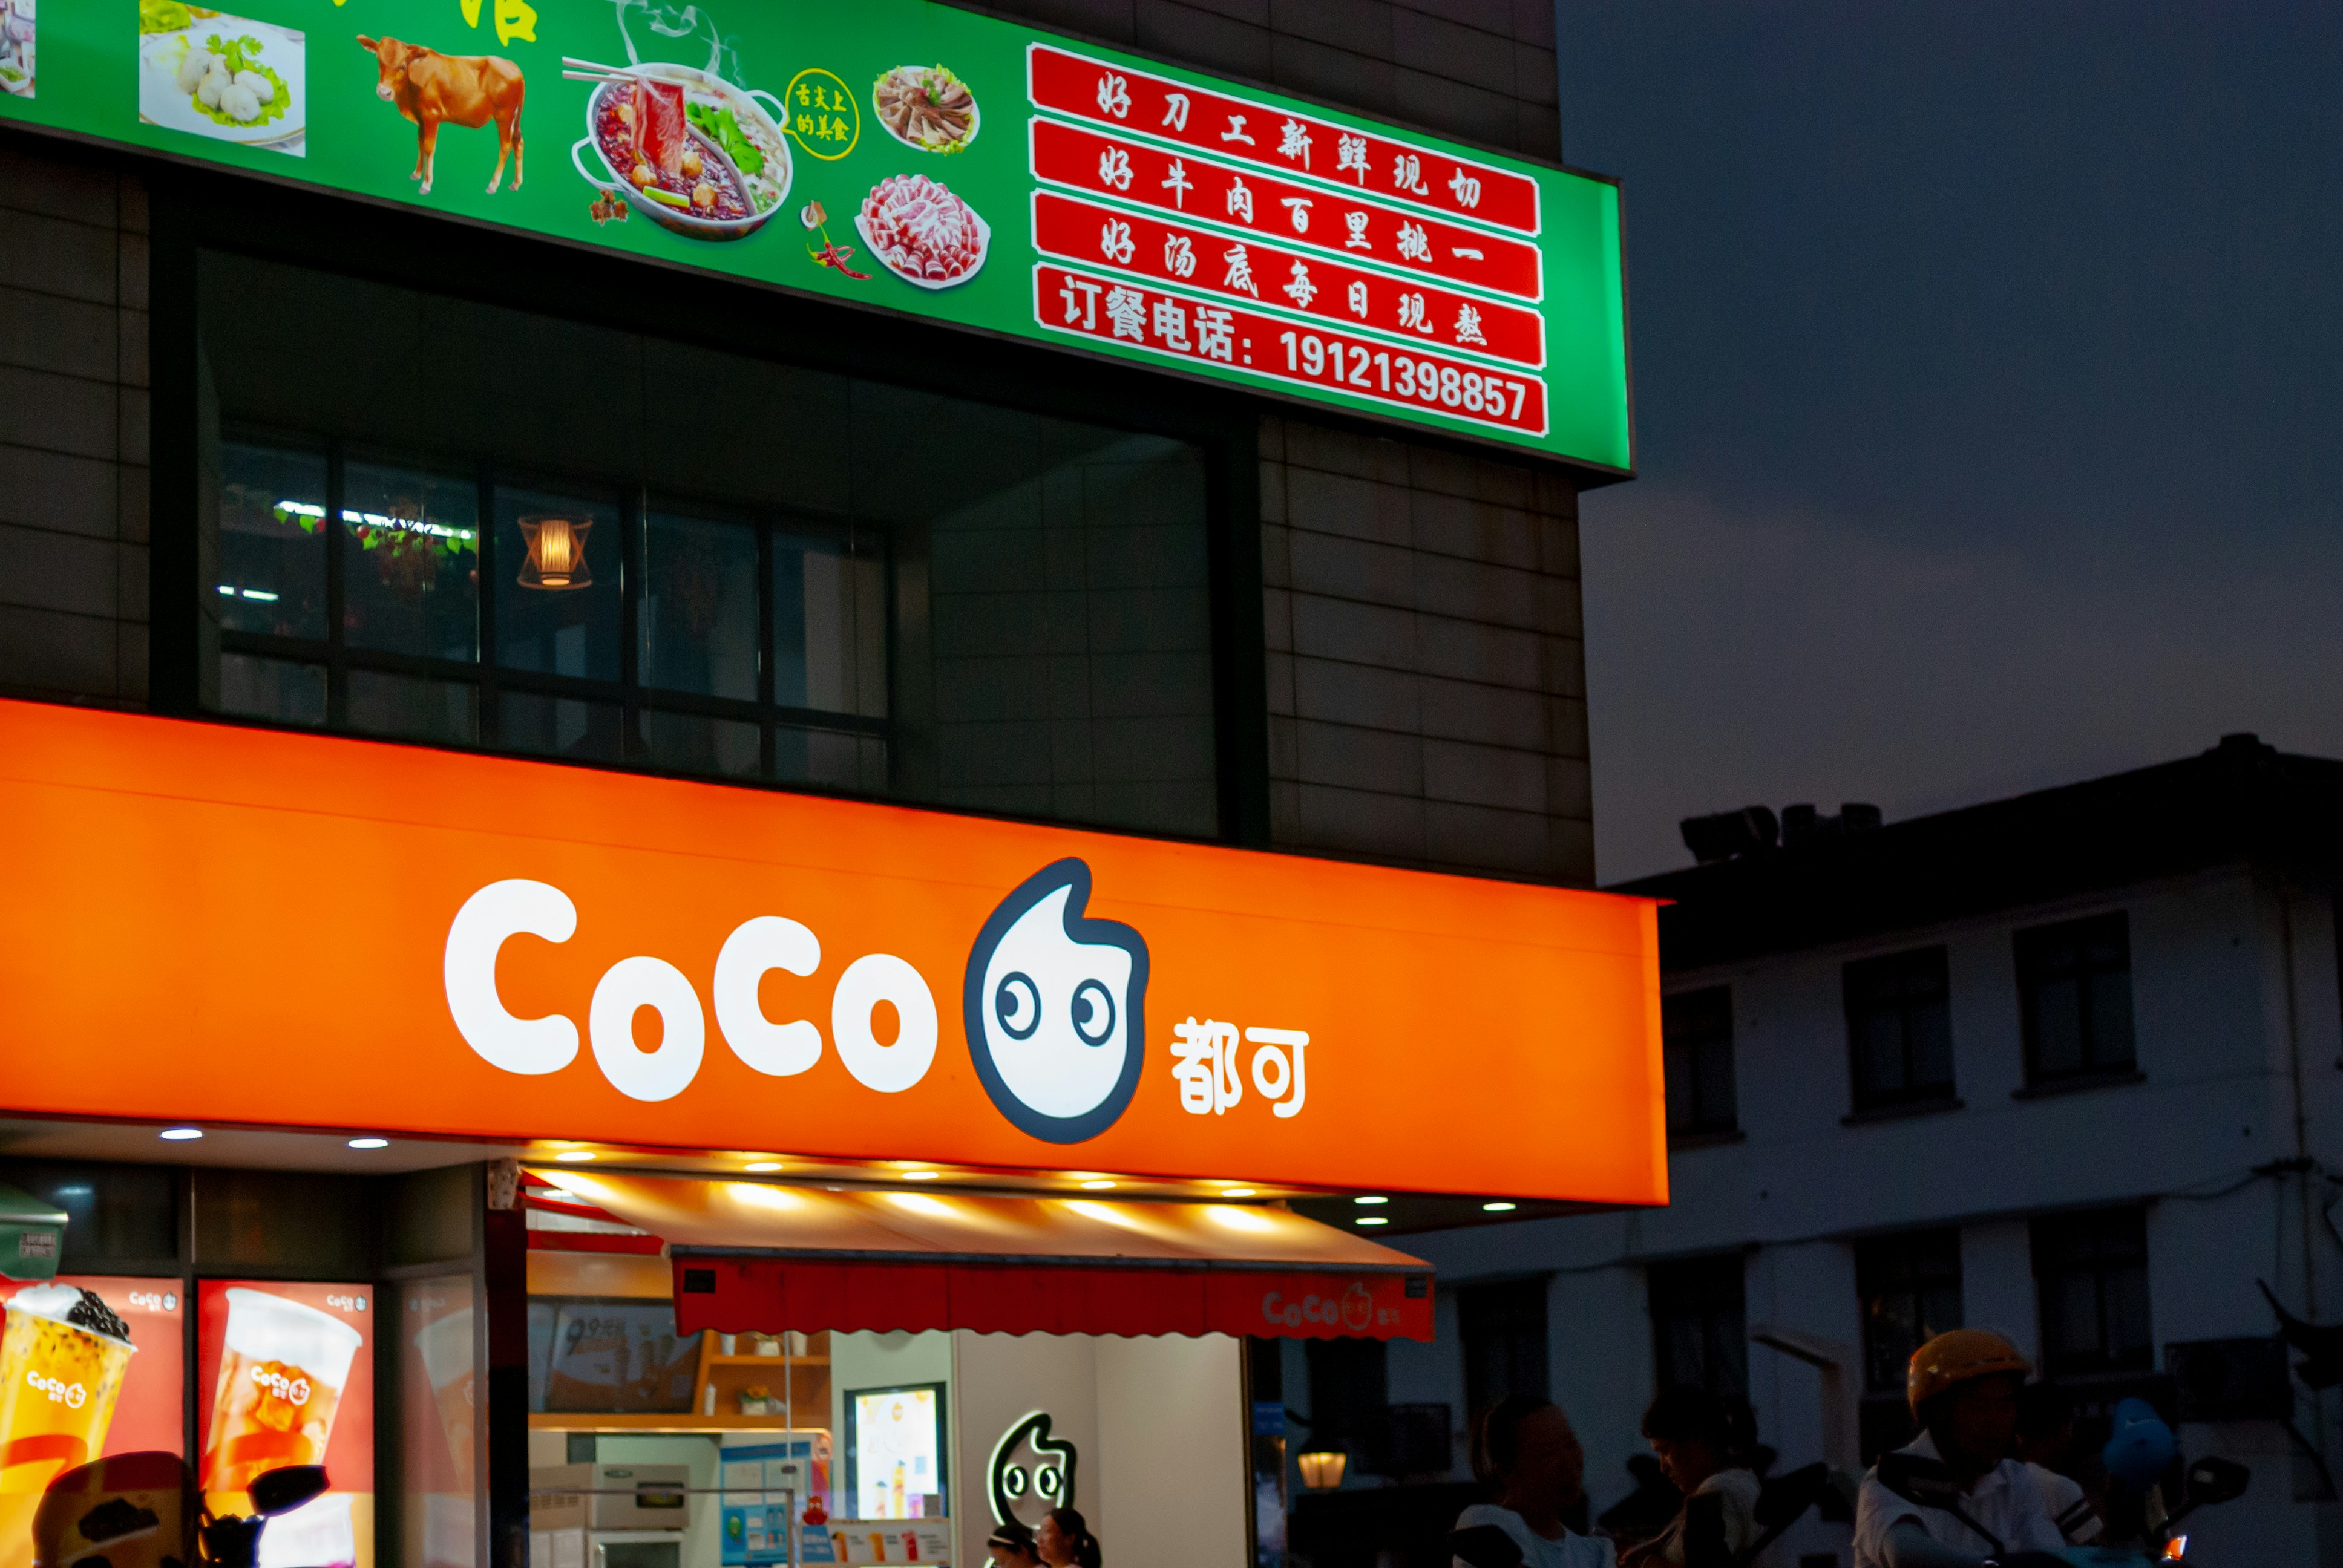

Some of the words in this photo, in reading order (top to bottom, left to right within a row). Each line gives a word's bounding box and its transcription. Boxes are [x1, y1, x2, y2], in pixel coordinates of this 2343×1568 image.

[795, 83, 847, 111] 舌尖上
[796, 114, 850, 141] 的美食
[1098, 71, 1481, 209] 好刀工新鲜现切
[1099, 145, 1484, 263] 好牛肉百里挑一
[1101, 218, 1487, 346] 好汤底每日现熬
[1280, 331, 1527, 420] 19121398857
[443, 878, 939, 1102] CoCo
[1170, 1016, 1310, 1118] 都可
[1262, 1290, 1339, 1328] CoCo
[26, 1370, 66, 1394] CoCo
[251, 1365, 290, 1391] CoCo
